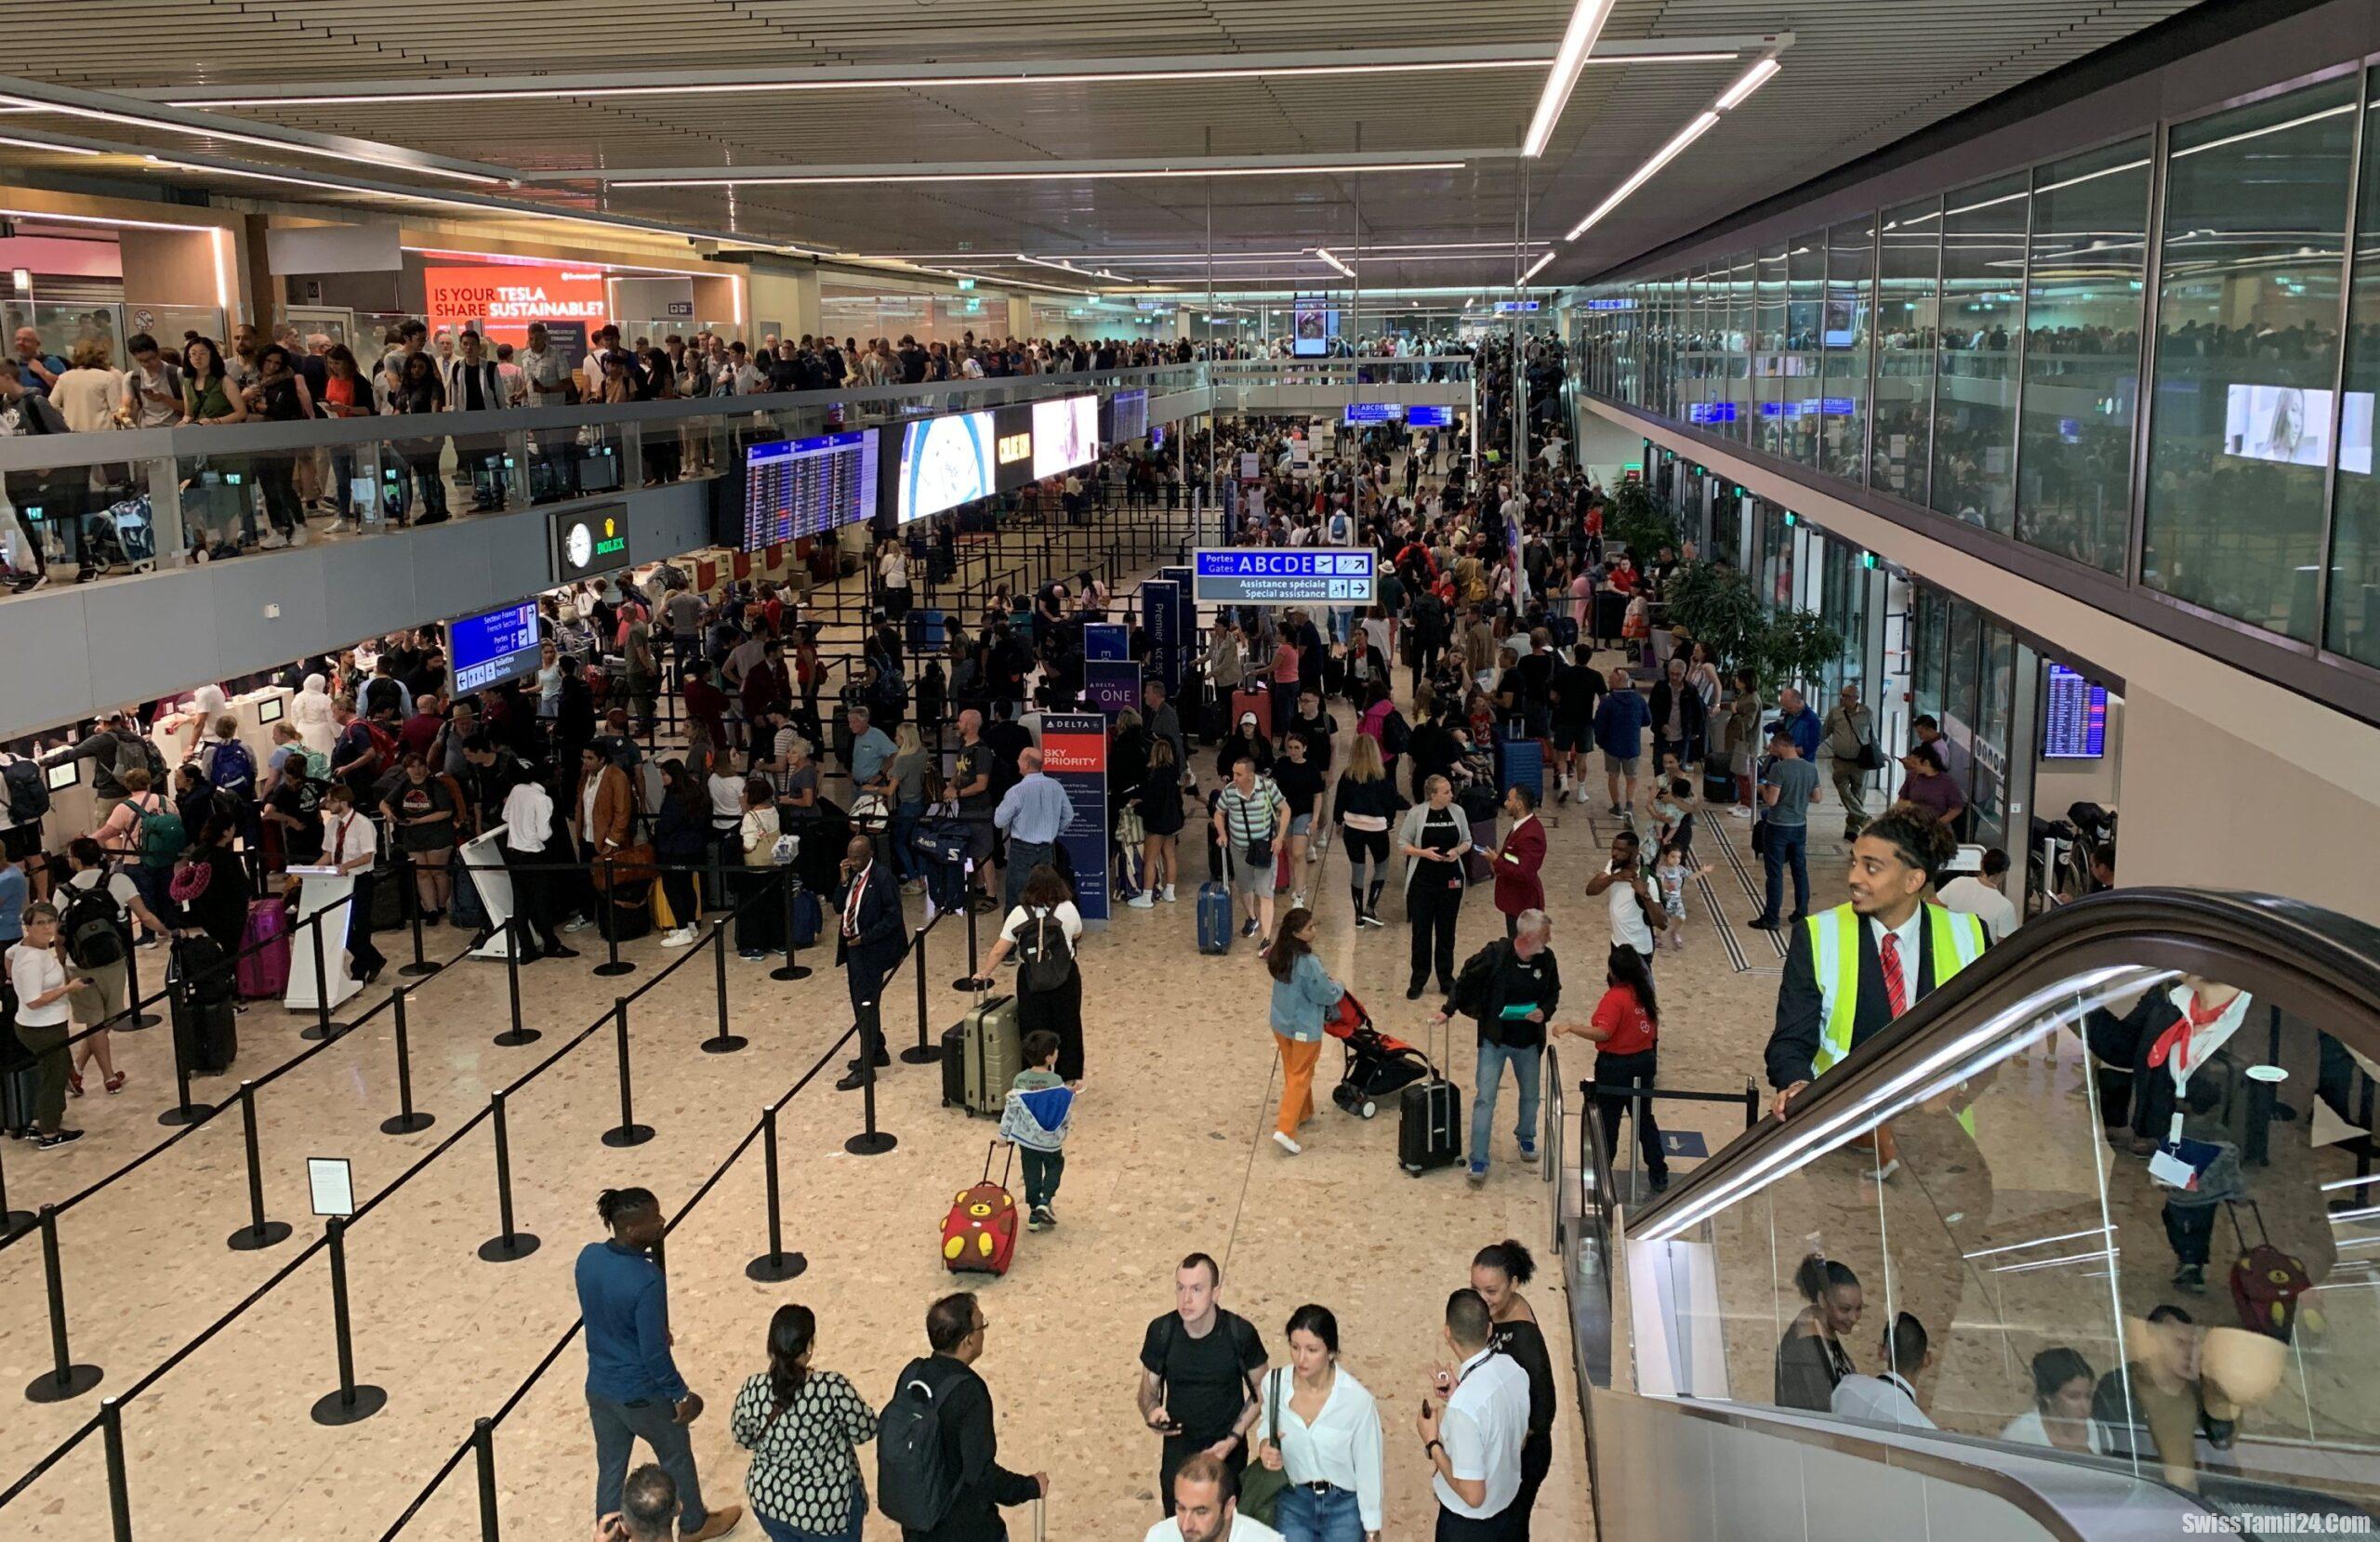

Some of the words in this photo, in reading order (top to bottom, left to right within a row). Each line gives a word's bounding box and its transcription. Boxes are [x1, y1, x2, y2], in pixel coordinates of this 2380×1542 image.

[434, 288, 447, 301] IS
[451, 288, 496, 301] YOUR
[496, 286, 547, 301] TESLA
[436, 303, 486, 316] SHARE
[489, 301, 604, 317] SUSTAINABLE?
[597, 537, 625, 555] ROLEX
[1206, 554, 1234, 563] Portes
[1238, 556, 1312, 573] ABCDE
[1209, 564, 1234, 573] Gates
[1239, 579, 1288, 588] Assistance
[1289, 579, 1326, 590] spéciale
[1245, 590, 1278, 600] Special
[483, 613, 502, 625] Secteur
[502, 610, 517, 619] France
[1155, 603, 1164, 641] Premier
[486, 624, 503, 633] French
[502, 619, 518, 629] Sector
[494, 634, 509, 644] Portes
[510, 633, 517, 649] F
[496, 644, 509, 653] Gates
[495, 655, 515, 667] Toilettes
[1101, 690, 1131, 702] ONE
[1044, 748, 1067, 758] SKY
[1044, 758, 1097, 766] PRIORITY
